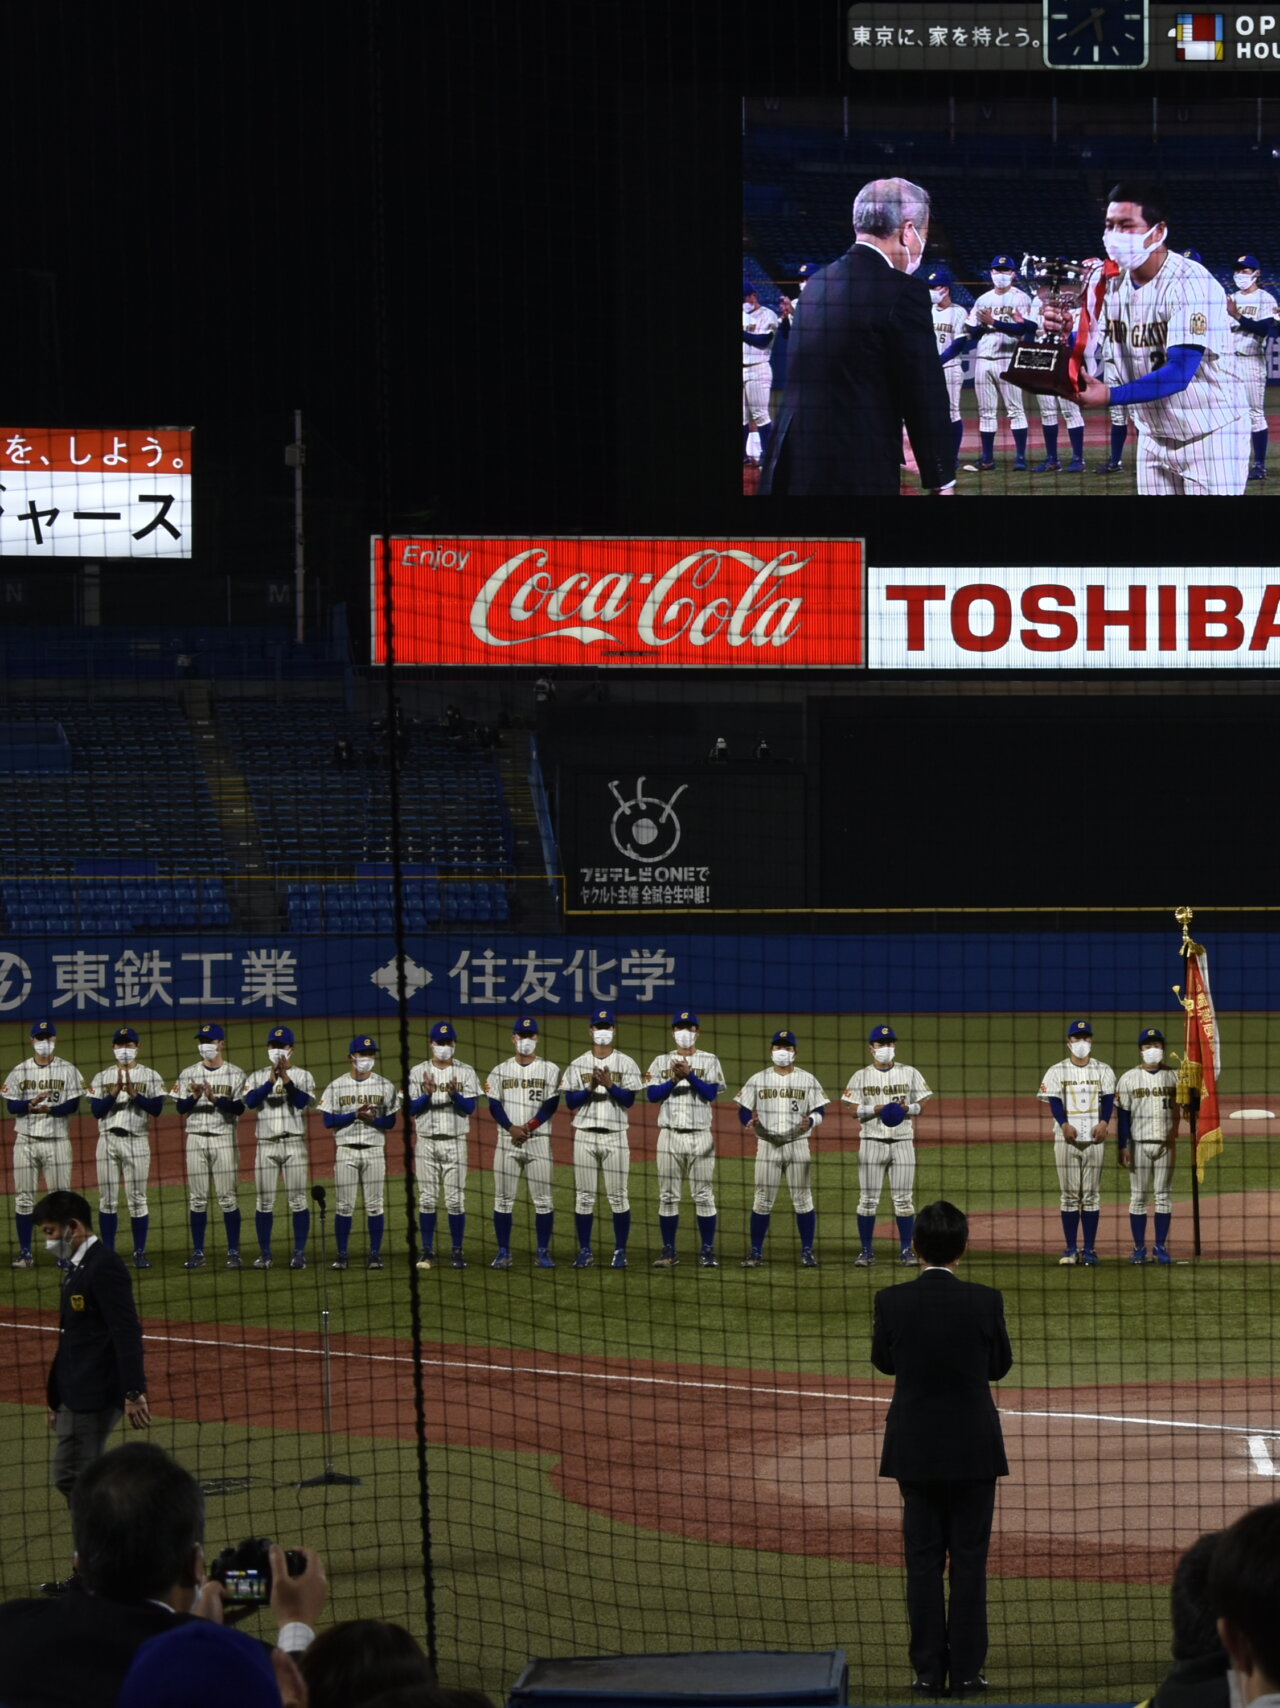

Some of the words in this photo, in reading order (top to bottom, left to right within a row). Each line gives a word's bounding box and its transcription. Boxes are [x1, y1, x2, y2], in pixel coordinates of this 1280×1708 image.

[851, 27, 1041, 49] 東京に、家を持とう。
[939, 333, 946, 344] 6
[5, 434, 184, 467] を、しよう。
[0, 484, 182, 545] ャース
[402, 545, 471, 571] Enjoy
[469, 548, 818, 647] Coca-Cola
[580, 866, 711, 882] フジテレビONEで
[52, 949, 298, 1009] 東鉄工業
[447, 948, 676, 1004] 住友化学
[529, 1090, 543, 1101] 25
[758, 1089, 778, 1100] CHUO
[780, 1089, 806, 1100] GAKUIN
[863, 1086, 880, 1096] CHUO
[791, 1101, 799, 1112] 3
